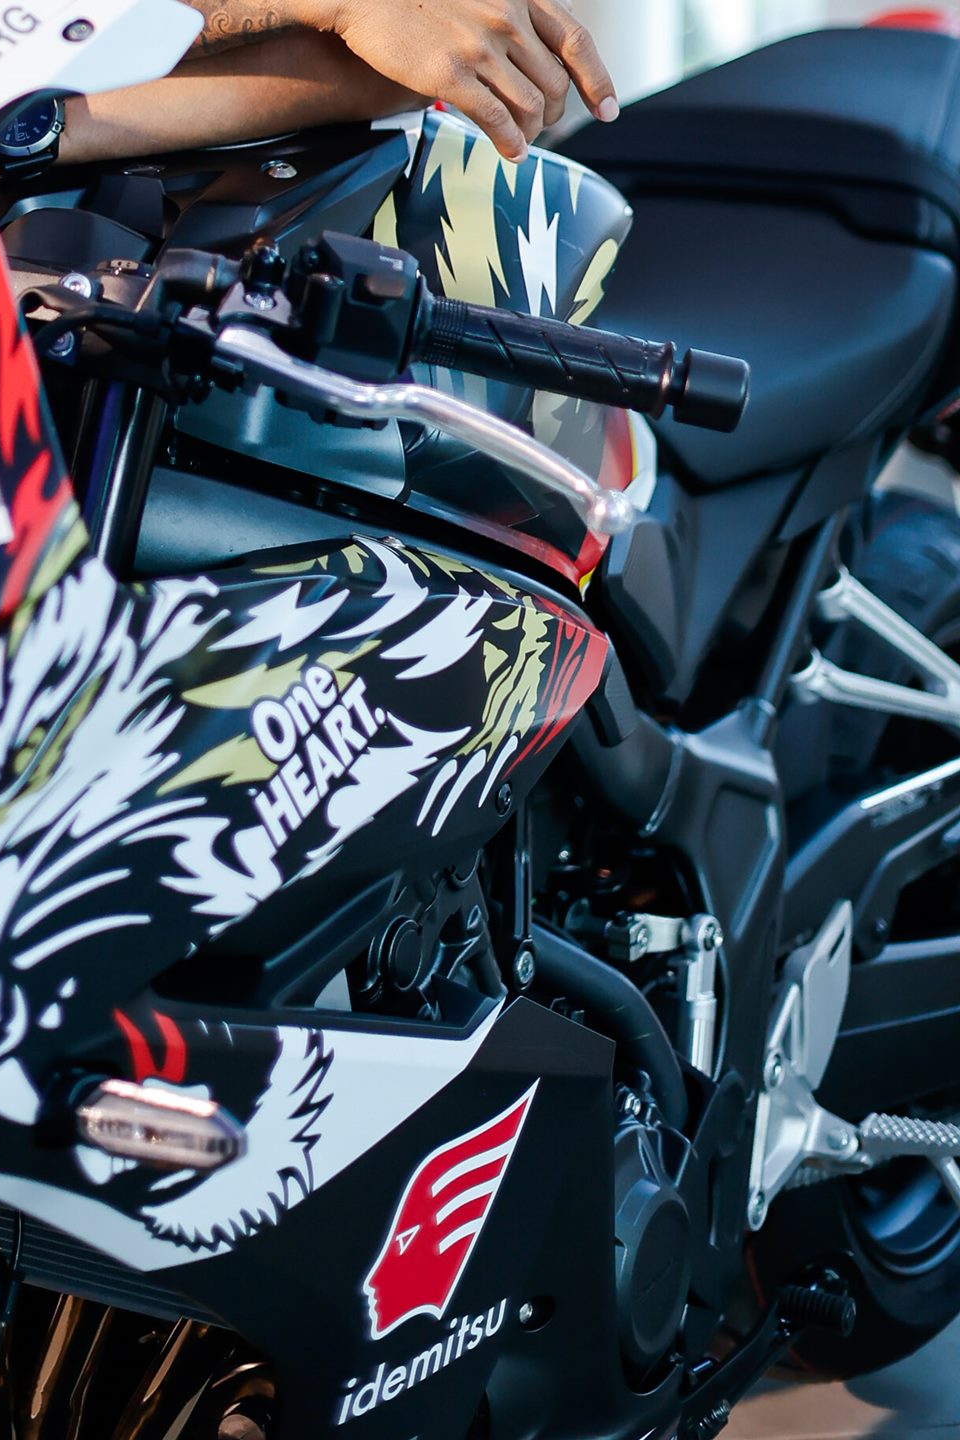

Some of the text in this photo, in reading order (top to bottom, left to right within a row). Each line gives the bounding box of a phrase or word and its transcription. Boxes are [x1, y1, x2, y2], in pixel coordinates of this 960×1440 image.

[252, 665, 339, 762] One
[253, 676, 386, 848] HEART.
[336, 1297, 508, 1426] idemitsu
